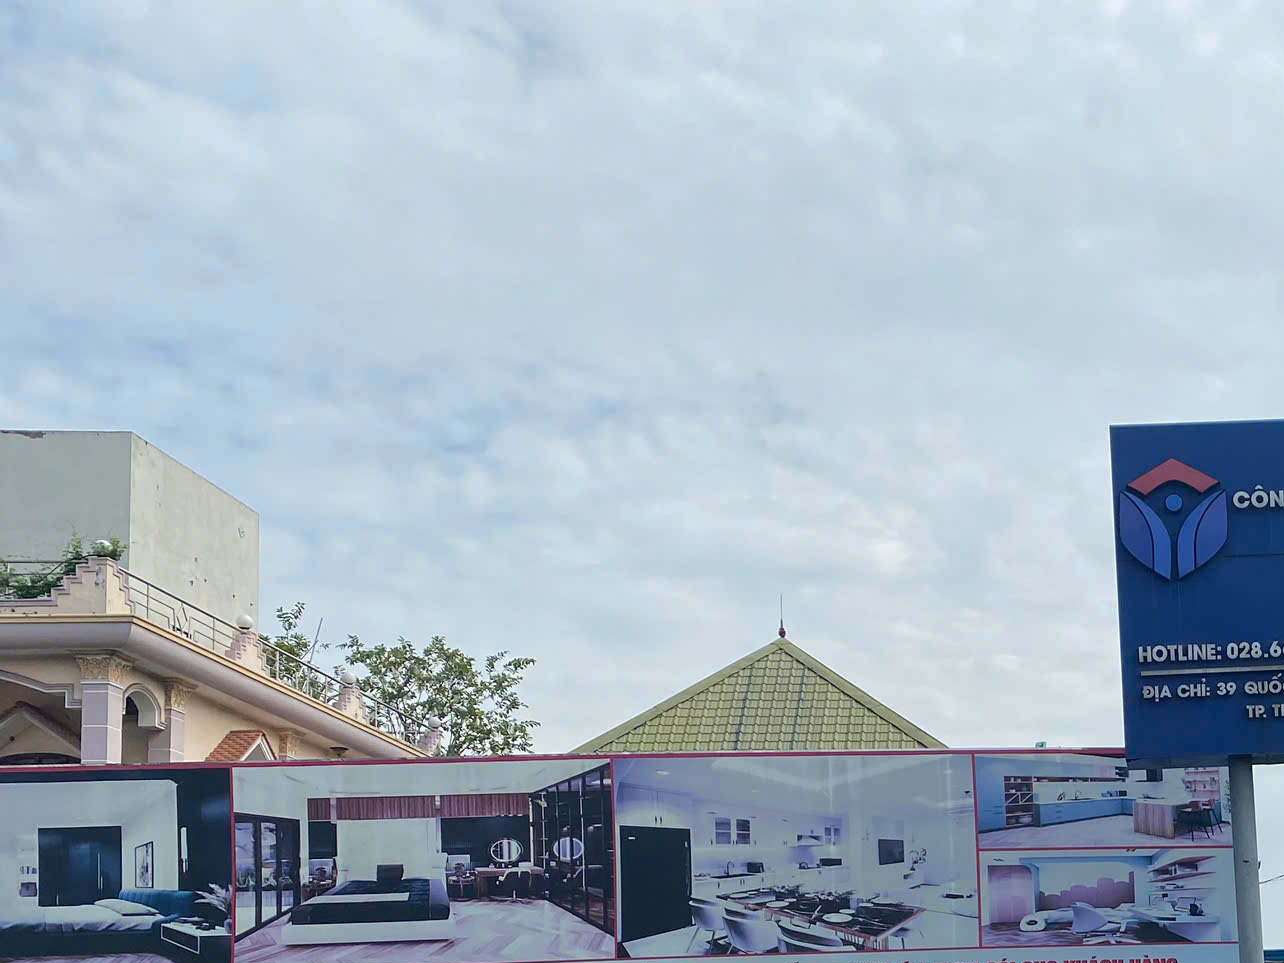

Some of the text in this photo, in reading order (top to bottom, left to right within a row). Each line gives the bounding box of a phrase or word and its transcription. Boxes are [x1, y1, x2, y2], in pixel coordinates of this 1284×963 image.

[1138, 643, 1222, 663] HOTLINE:
[1143, 685, 1172, 702] ĐỊA
[1177, 678, 1211, 698] CHỈ:
[1216, 681, 1237, 696] 39
[1246, 705, 1267, 719] TP.
